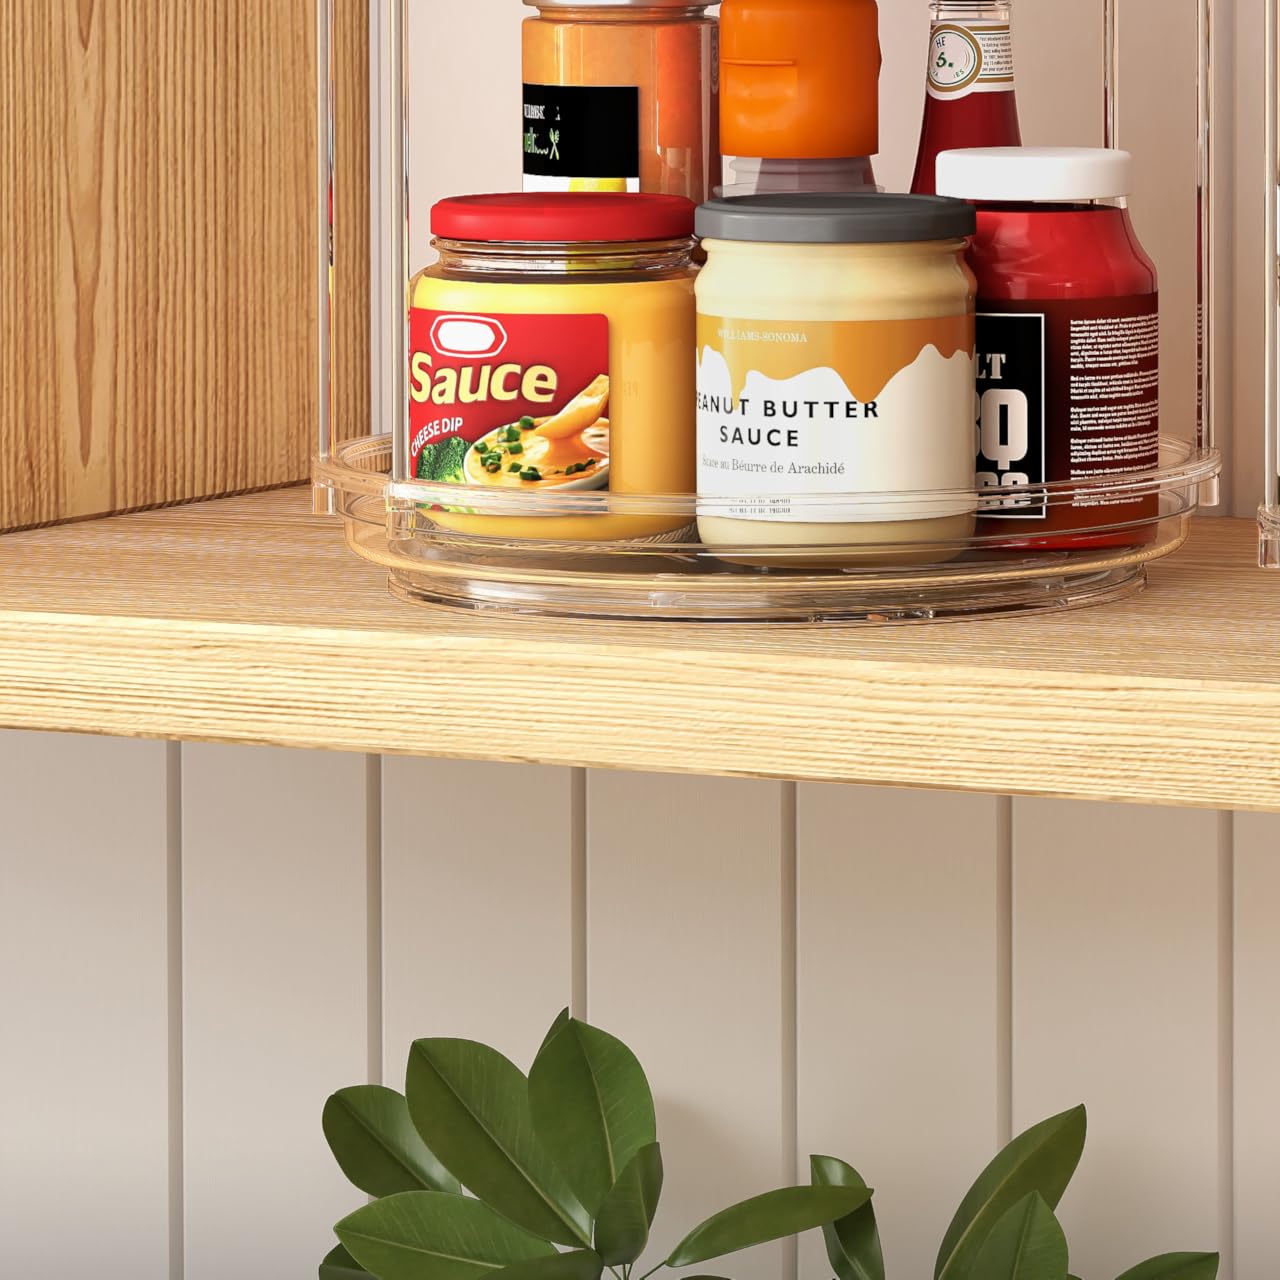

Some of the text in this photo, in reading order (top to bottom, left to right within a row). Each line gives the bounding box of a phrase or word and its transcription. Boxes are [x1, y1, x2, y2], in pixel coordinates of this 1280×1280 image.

[410, 351, 558, 405] Sauce
[762, 400, 879, 419] BUTTER
[410, 416, 464, 457] CHEESE DIP
[719, 425, 799, 448] SAUCE
[769, 461, 785, 474] de
